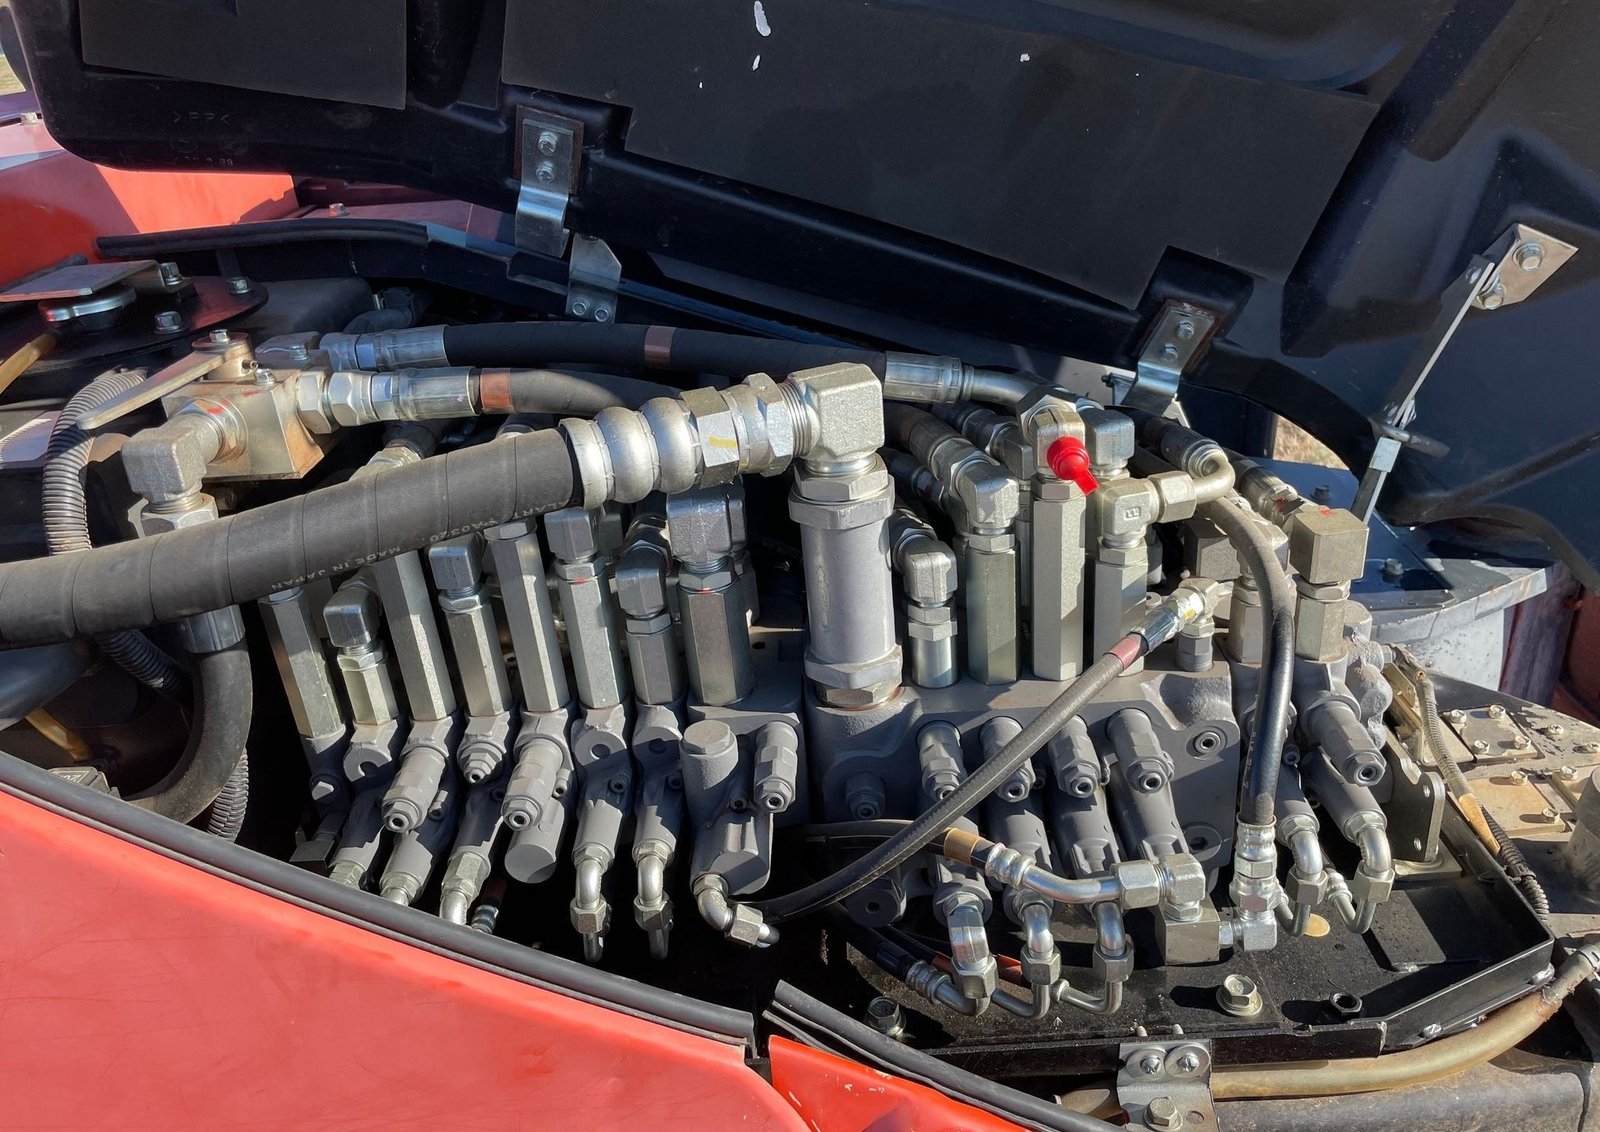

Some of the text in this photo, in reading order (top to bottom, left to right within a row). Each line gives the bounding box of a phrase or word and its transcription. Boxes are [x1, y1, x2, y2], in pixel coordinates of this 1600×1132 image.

[355, 546, 401, 565] MADE
[332, 561, 351, 572] IN
[271, 569, 327, 590] JAPAN
